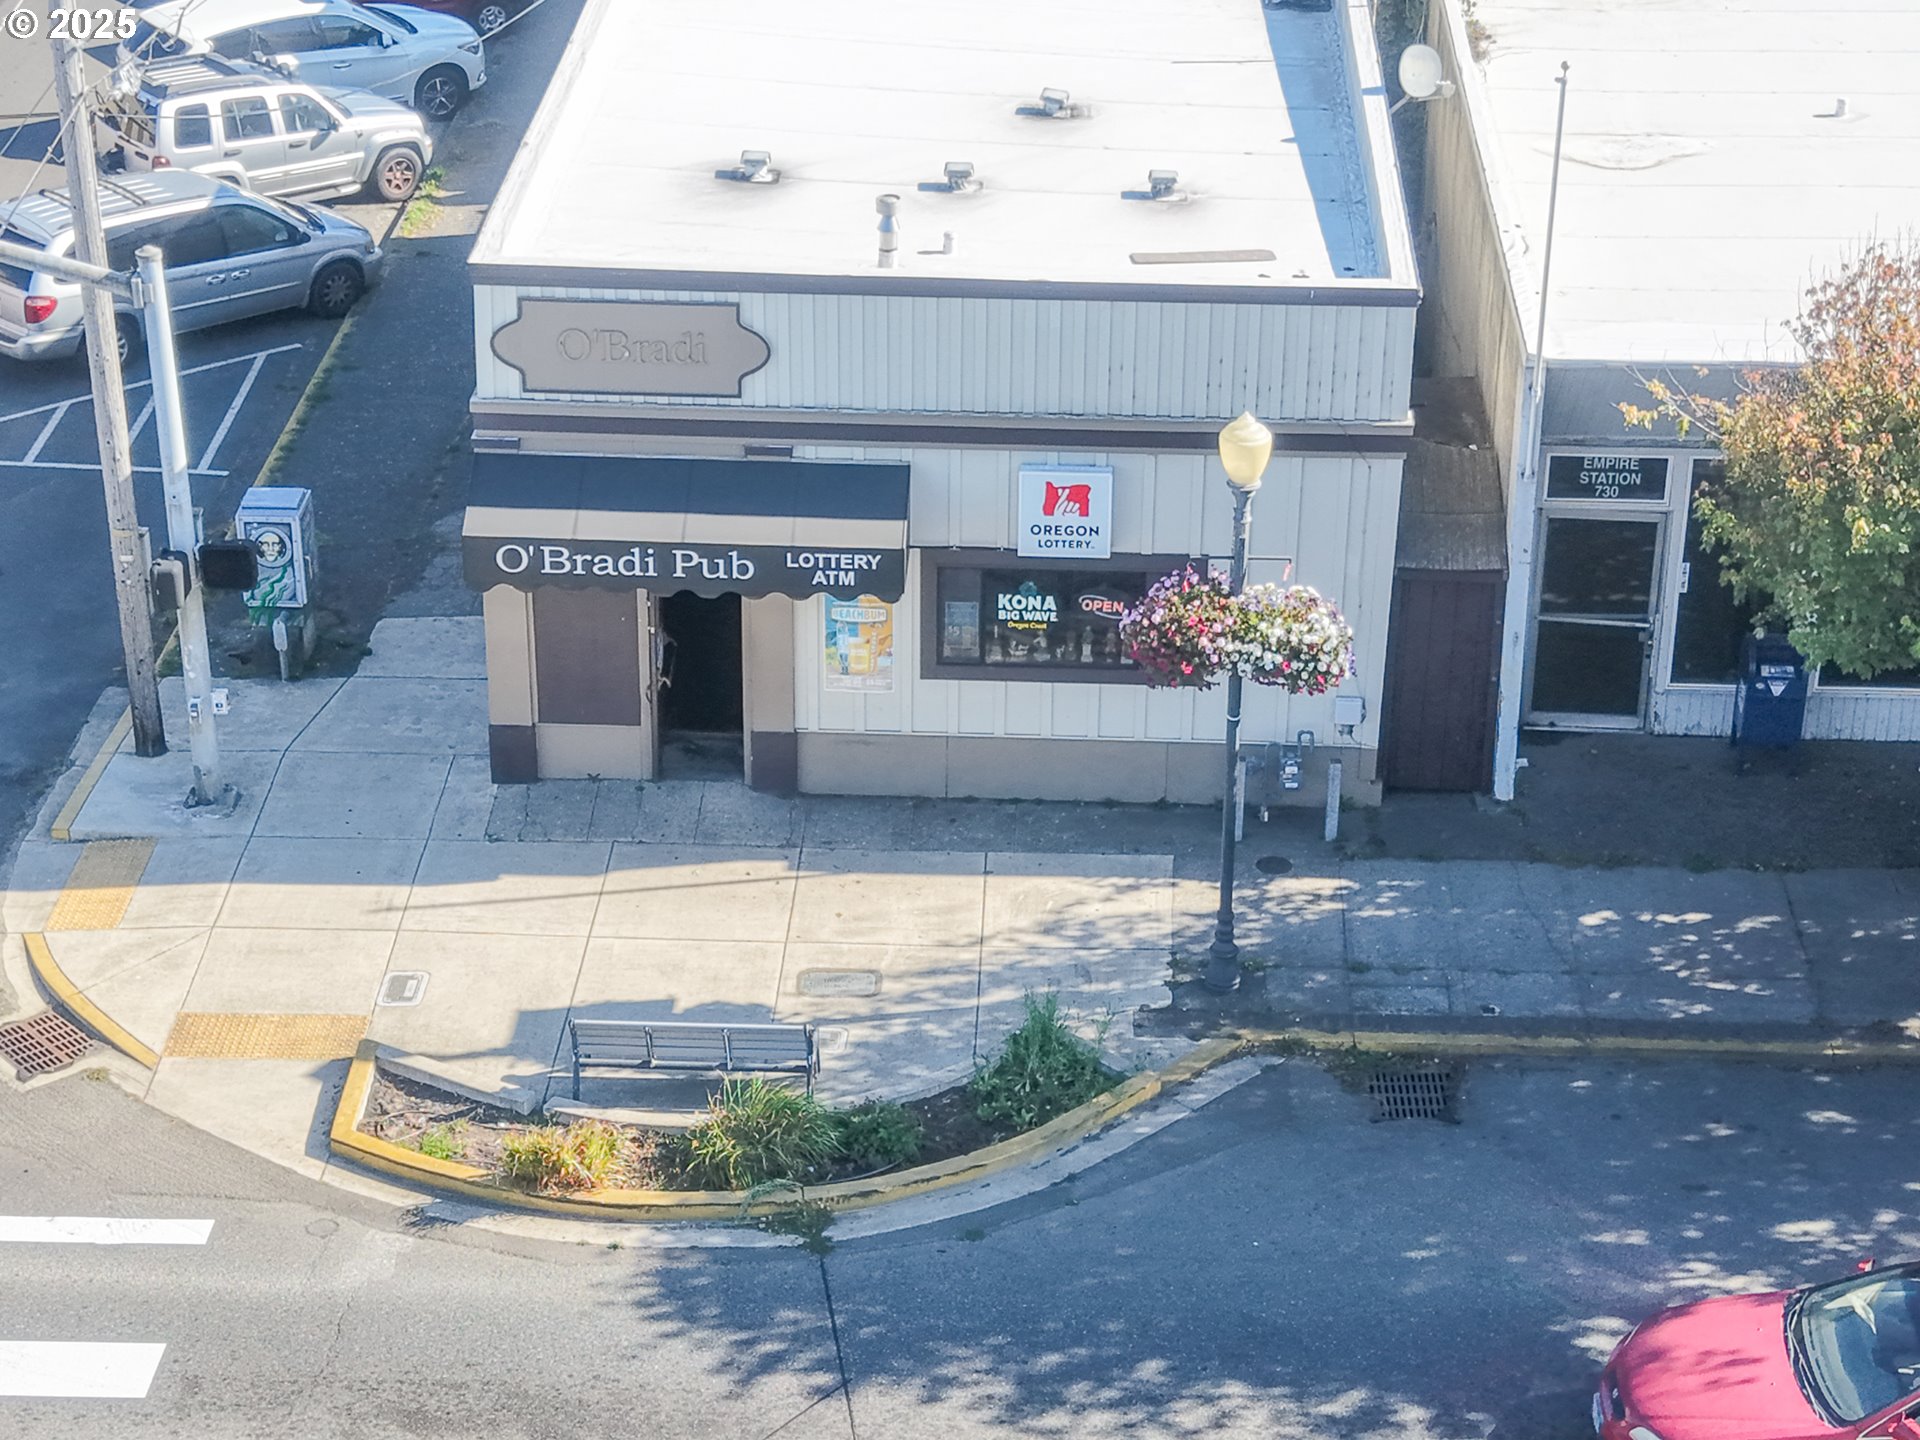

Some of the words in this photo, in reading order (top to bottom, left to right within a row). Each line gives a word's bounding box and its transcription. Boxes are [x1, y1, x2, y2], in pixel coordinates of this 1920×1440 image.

[557, 327, 708, 364] O'Bradi
[1583, 457, 1640, 470] EMPIRE
[1579, 471, 1641, 485] STATION
[1594, 486, 1619, 498] 730
[1030, 524, 1099, 537] OREGON
[1038, 539, 1092, 549] LOTTERY
[495, 544, 658, 577] O'Bradi
[672, 549, 755, 580] Pub
[786, 552, 882, 570] LOTTERY
[812, 570, 855, 586] ATM
[997, 593, 1057, 611] KONA
[1081, 599, 1124, 613] OPEN
[998, 610, 1020, 621] BIG
[1021, 611, 1058, 622] WAVE
